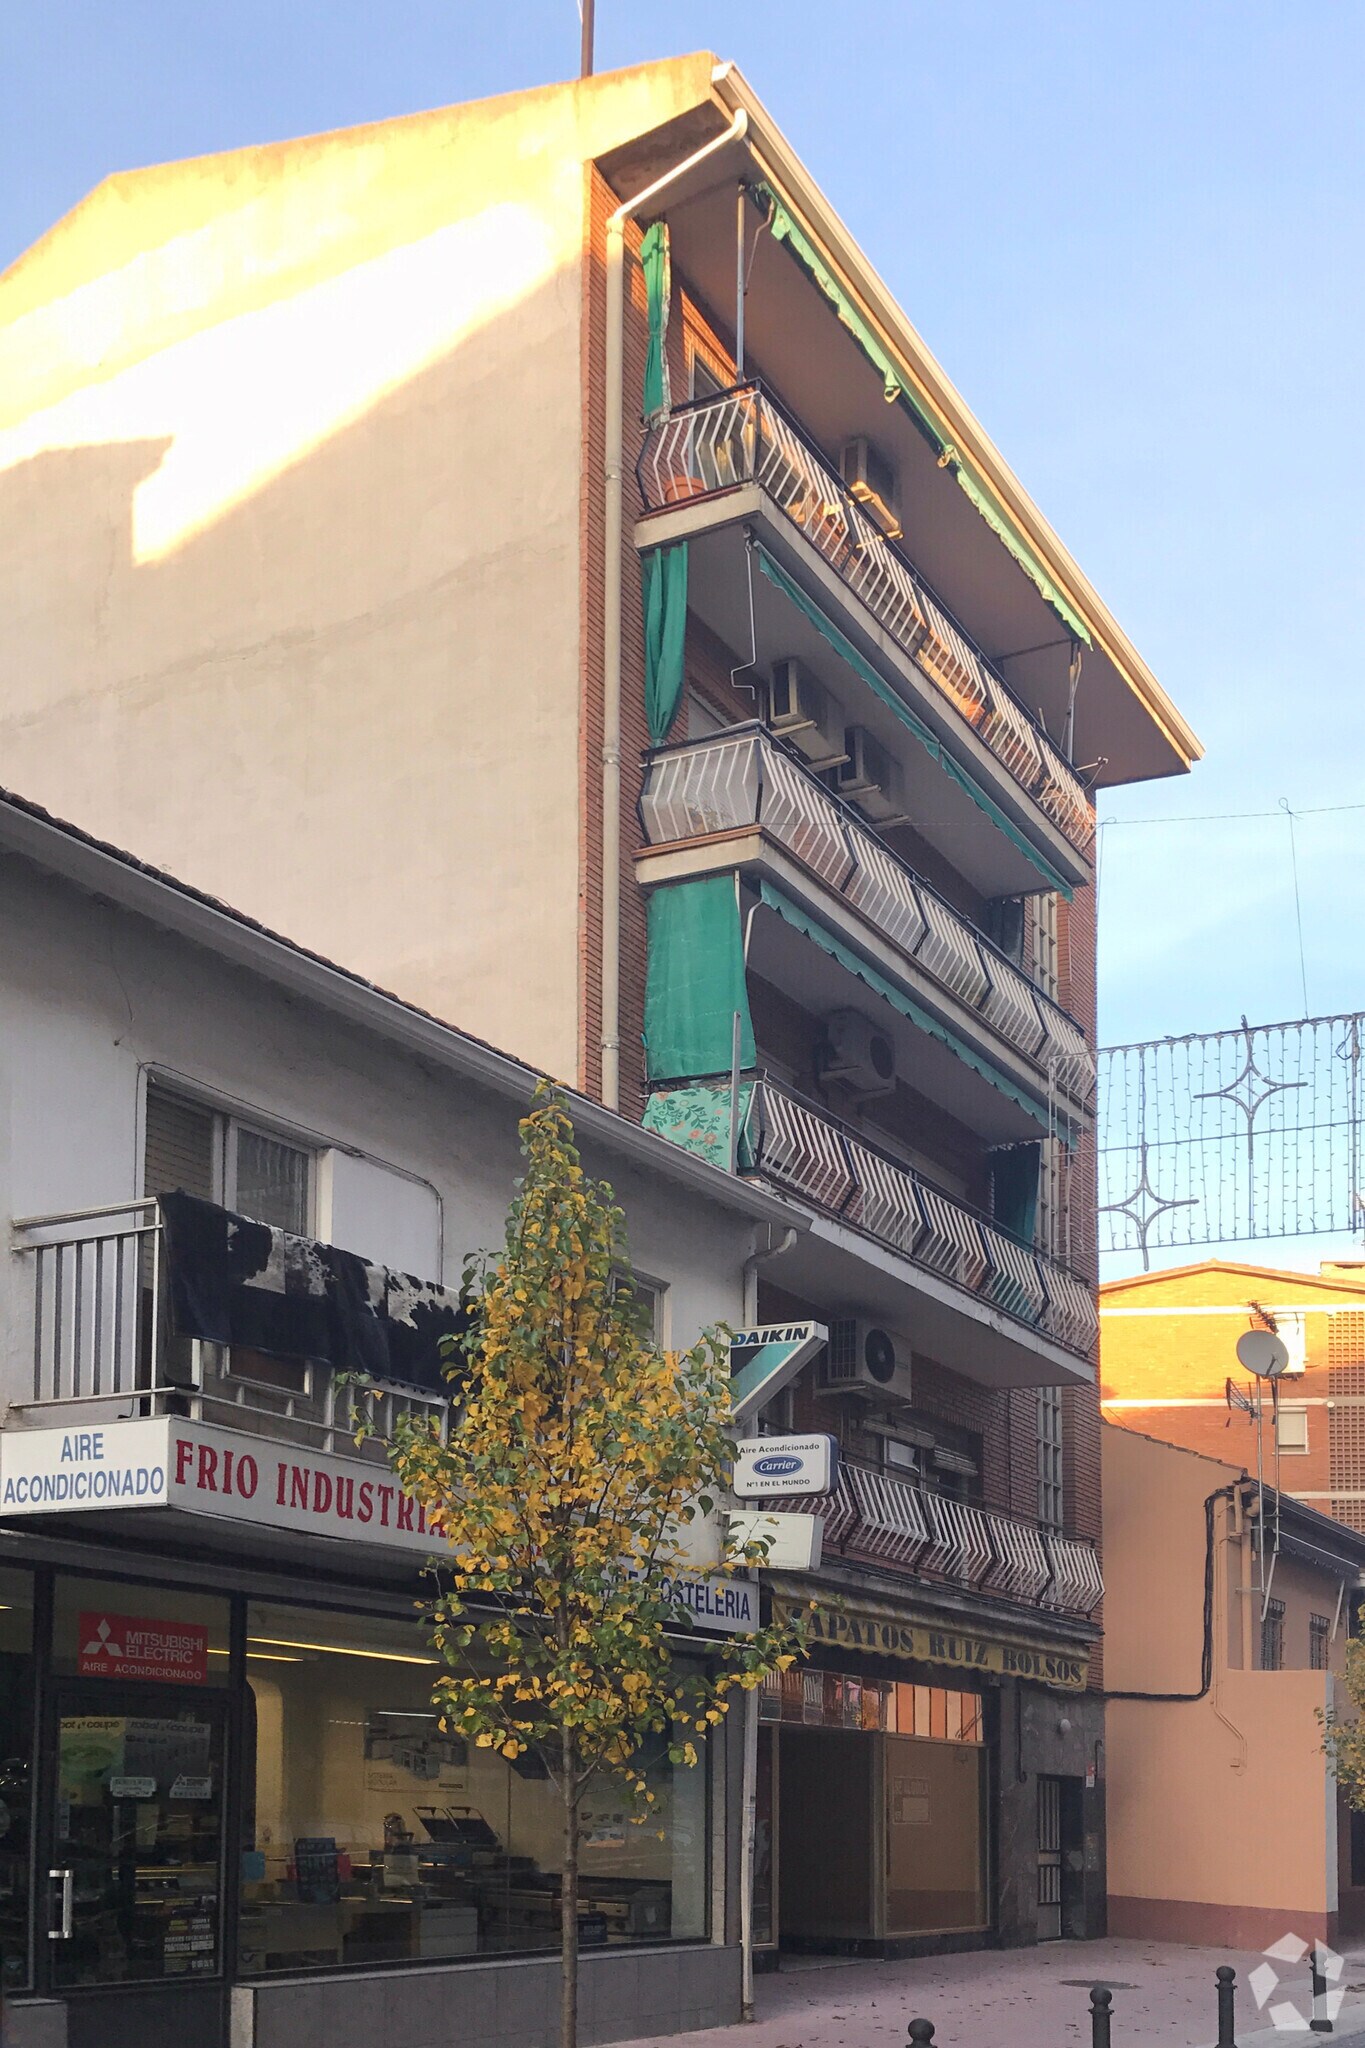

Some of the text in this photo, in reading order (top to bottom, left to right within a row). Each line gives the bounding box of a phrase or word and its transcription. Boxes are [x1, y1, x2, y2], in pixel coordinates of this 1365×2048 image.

[730, 1326, 809, 1346] DAIKIN
[60, 1432, 105, 1462] AIRE
[758, 1443, 820, 1453] Acondicionado
[759, 1460, 797, 1471] Carrier
[3, 1466, 165, 1504] ACONDICIONADO
[174, 1438, 453, 1539] FRIO INDUSTRIA
[782, 1478, 811, 1486] MUNDO
[126, 1630, 203, 1651] MITSUBISHI
[126, 1645, 193, 1664] ELECTRIC
[928, 1633, 989, 1666] RUIZ
[1001, 1647, 1082, 1684] BOLSOS
[82, 1662, 202, 1680] AIRE ACONDICIONADO
